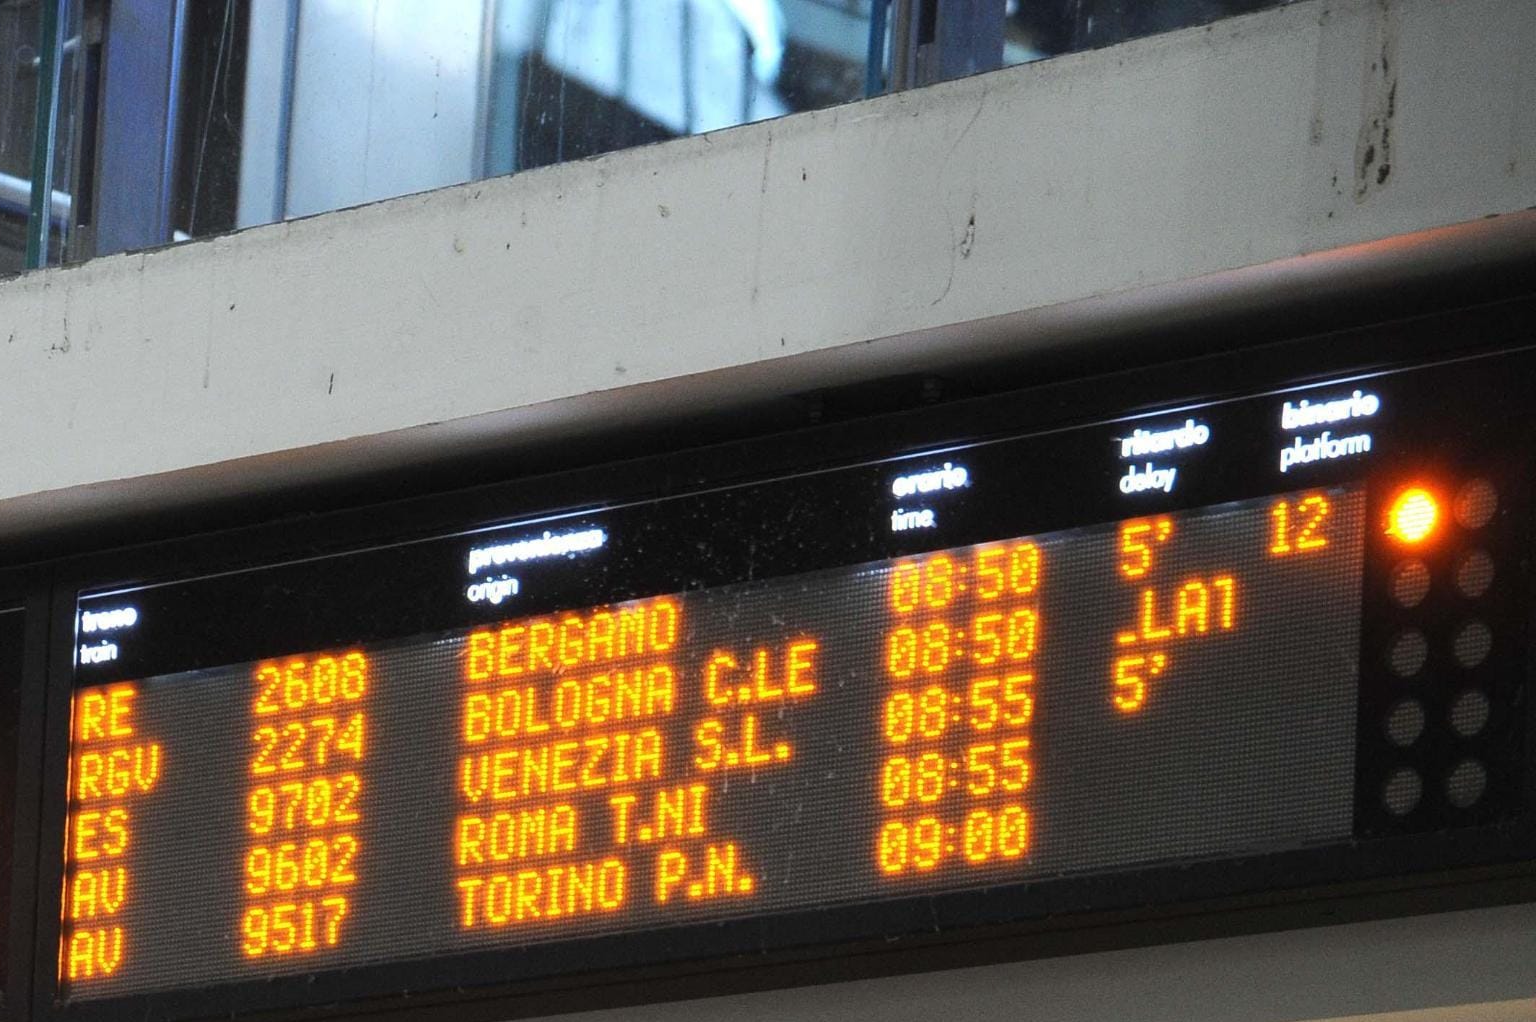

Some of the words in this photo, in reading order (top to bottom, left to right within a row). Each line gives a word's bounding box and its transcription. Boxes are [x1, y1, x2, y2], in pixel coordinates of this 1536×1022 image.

[1120, 420, 1210, 458] ritardo
[1281, 391, 1378, 430] binario
[80, 640, 118, 664] train
[467, 574, 518, 604] origin
[891, 506, 934, 531] time
[1120, 463, 1176, 494] delay
[1280, 433, 1371, 472] platform
[80, 689, 134, 740] RE
[255, 652, 367, 714] 2608
[470, 602, 677, 680] BERGAMO
[891, 543, 1040, 610] 08:50
[1271, 496, 1328, 554] 12
[75, 809, 128, 859] ES
[249, 774, 360, 834] 9702
[463, 729, 661, 802] VENEZIA
[695, 717, 789, 770] S.L.
[885, 674, 1033, 743] 08:55
[78, 744, 159, 800] RGV
[252, 713, 364, 774] 2274
[465, 665, 673, 742] BOLOGNA
[707, 643, 817, 705] C.LE
[889, 609, 1037, 678] 08:50
[69, 928, 122, 978] AV
[243, 897, 346, 955] 9517
[457, 860, 625, 927] TORINO
[658, 846, 752, 901] P.N.
[879, 805, 1027, 872] 09:00
[72, 867, 127, 919] AV
[246, 835, 357, 894] 9602
[459, 804, 576, 865] ROMA
[610, 785, 706, 844] T.NI
[882, 739, 1030, 807] 08:55
